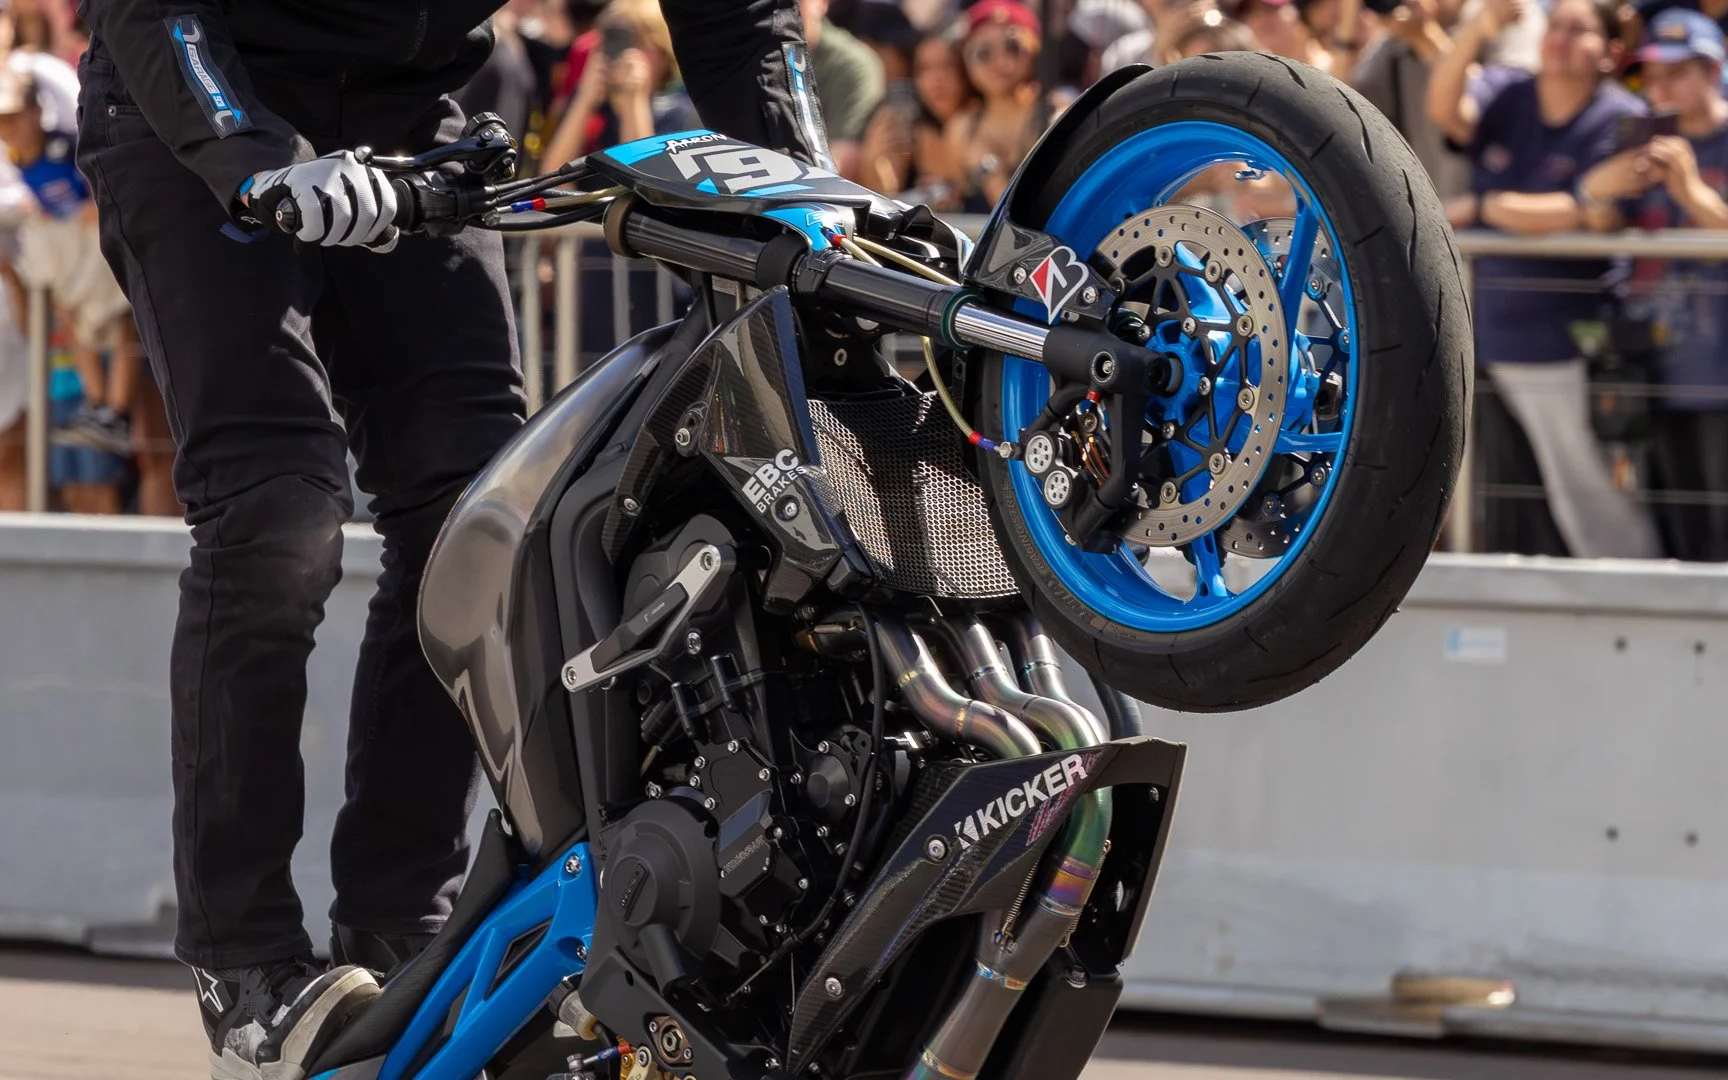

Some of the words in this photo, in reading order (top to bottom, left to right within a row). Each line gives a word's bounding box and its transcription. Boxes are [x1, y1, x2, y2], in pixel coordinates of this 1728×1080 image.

[741, 448, 799, 506] EBC
[756, 466, 807, 514] BRAKES
[975, 753, 1089, 837] KICKER
